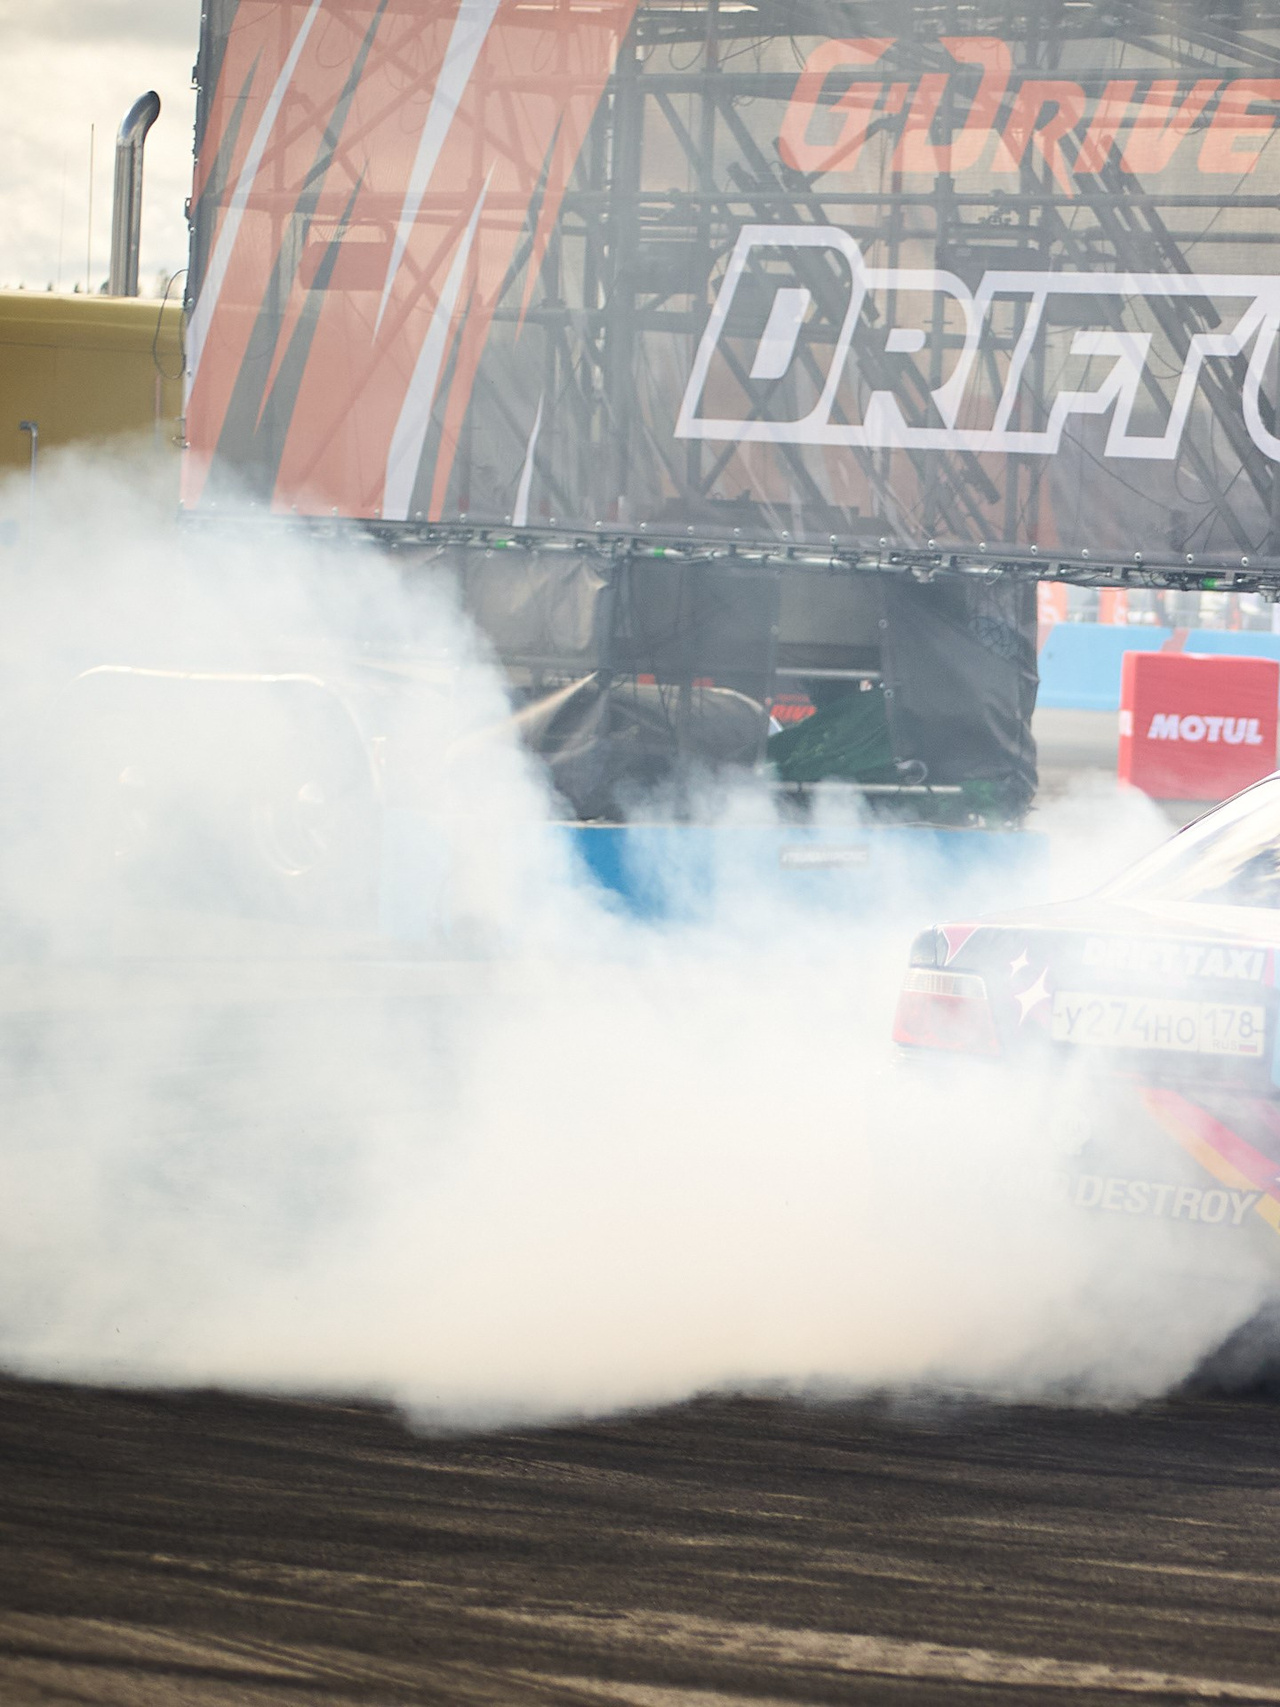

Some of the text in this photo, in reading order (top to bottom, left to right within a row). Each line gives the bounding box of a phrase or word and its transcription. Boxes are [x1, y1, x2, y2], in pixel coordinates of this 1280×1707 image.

[1148, 713, 1263, 745] MOTUL
[1183, 945, 1265, 981] TAXI
[1204, 1008, 1254, 1039] 178
[1212, 1039, 1238, 1050] RUS
[1074, 1174, 1258, 1225] DESTROY
